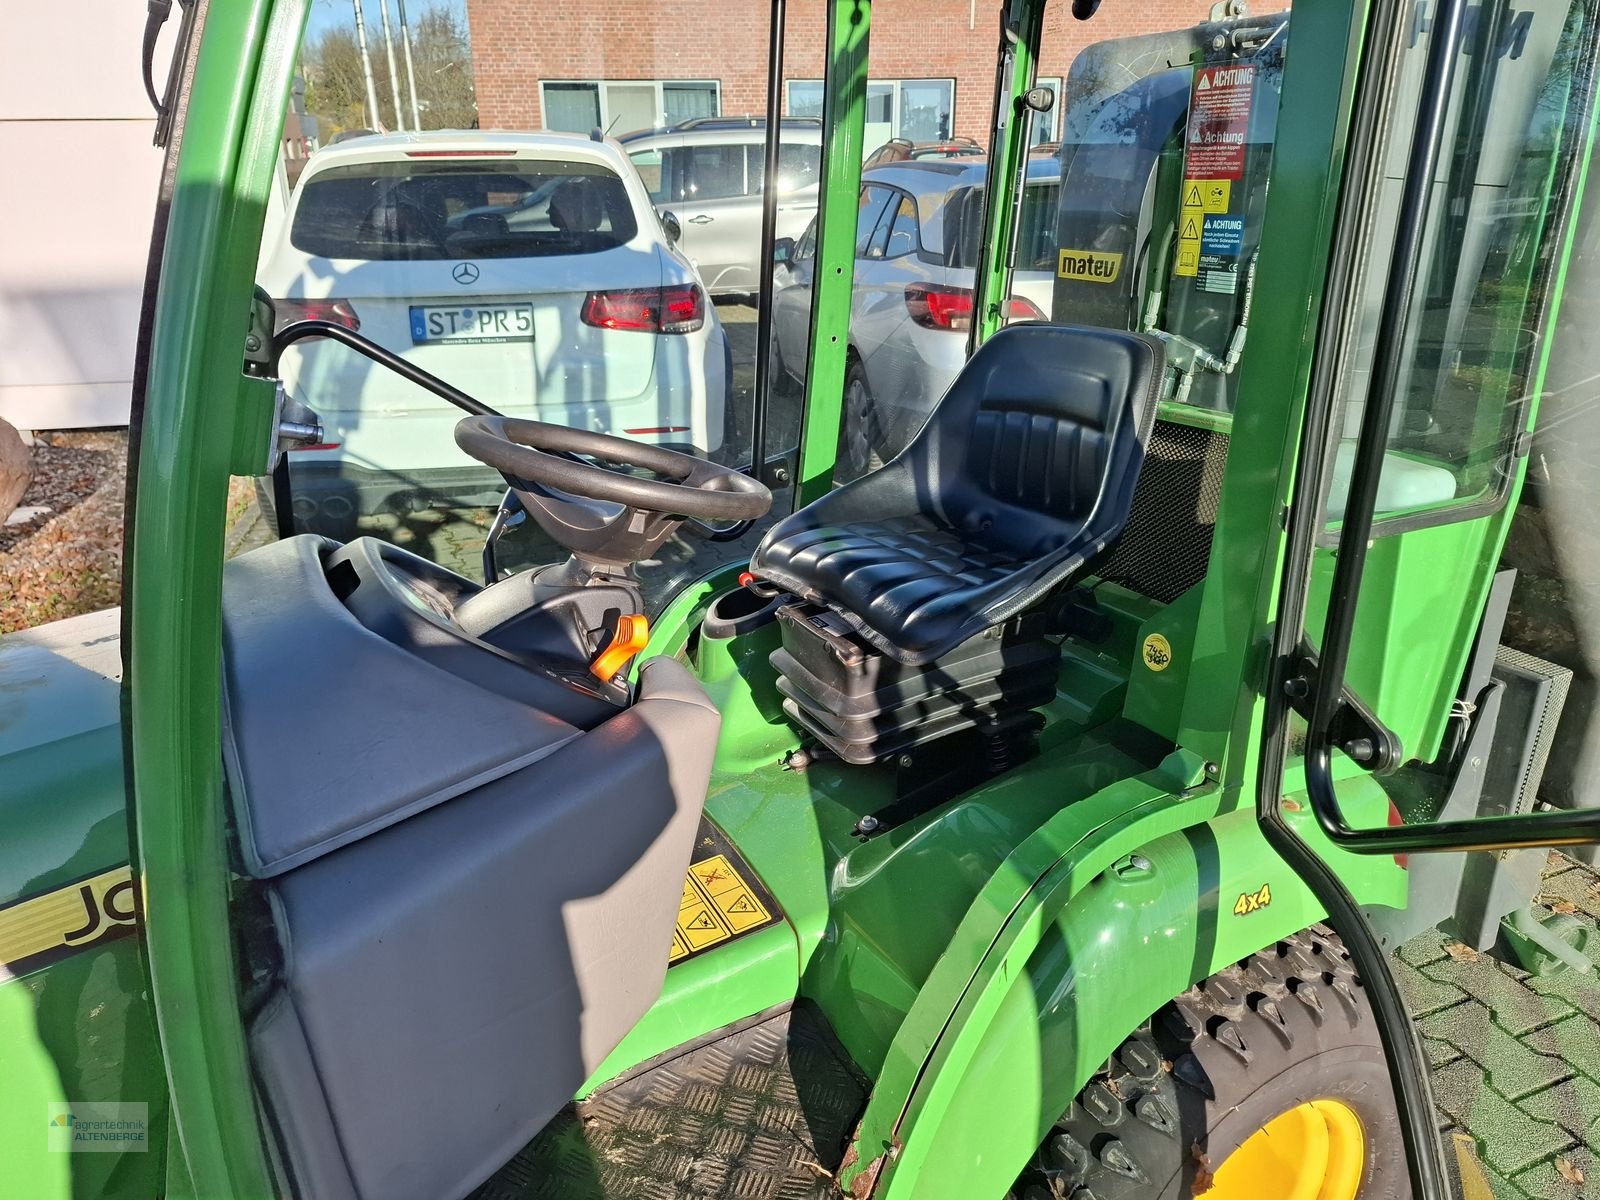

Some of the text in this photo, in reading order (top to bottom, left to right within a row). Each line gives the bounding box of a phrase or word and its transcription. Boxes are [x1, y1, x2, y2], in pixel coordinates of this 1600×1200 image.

[1212, 67, 1253, 88] ACHTUNG
[1204, 131, 1244, 145] Achtung
[1212, 219, 1243, 230] ACHTUNG
[1061, 254, 1116, 278] matev
[428, 311, 459, 336] ST
[478, 310, 510, 333] PR
[515, 309, 531, 331] 5
[1233, 882, 1272, 917] 4x4
